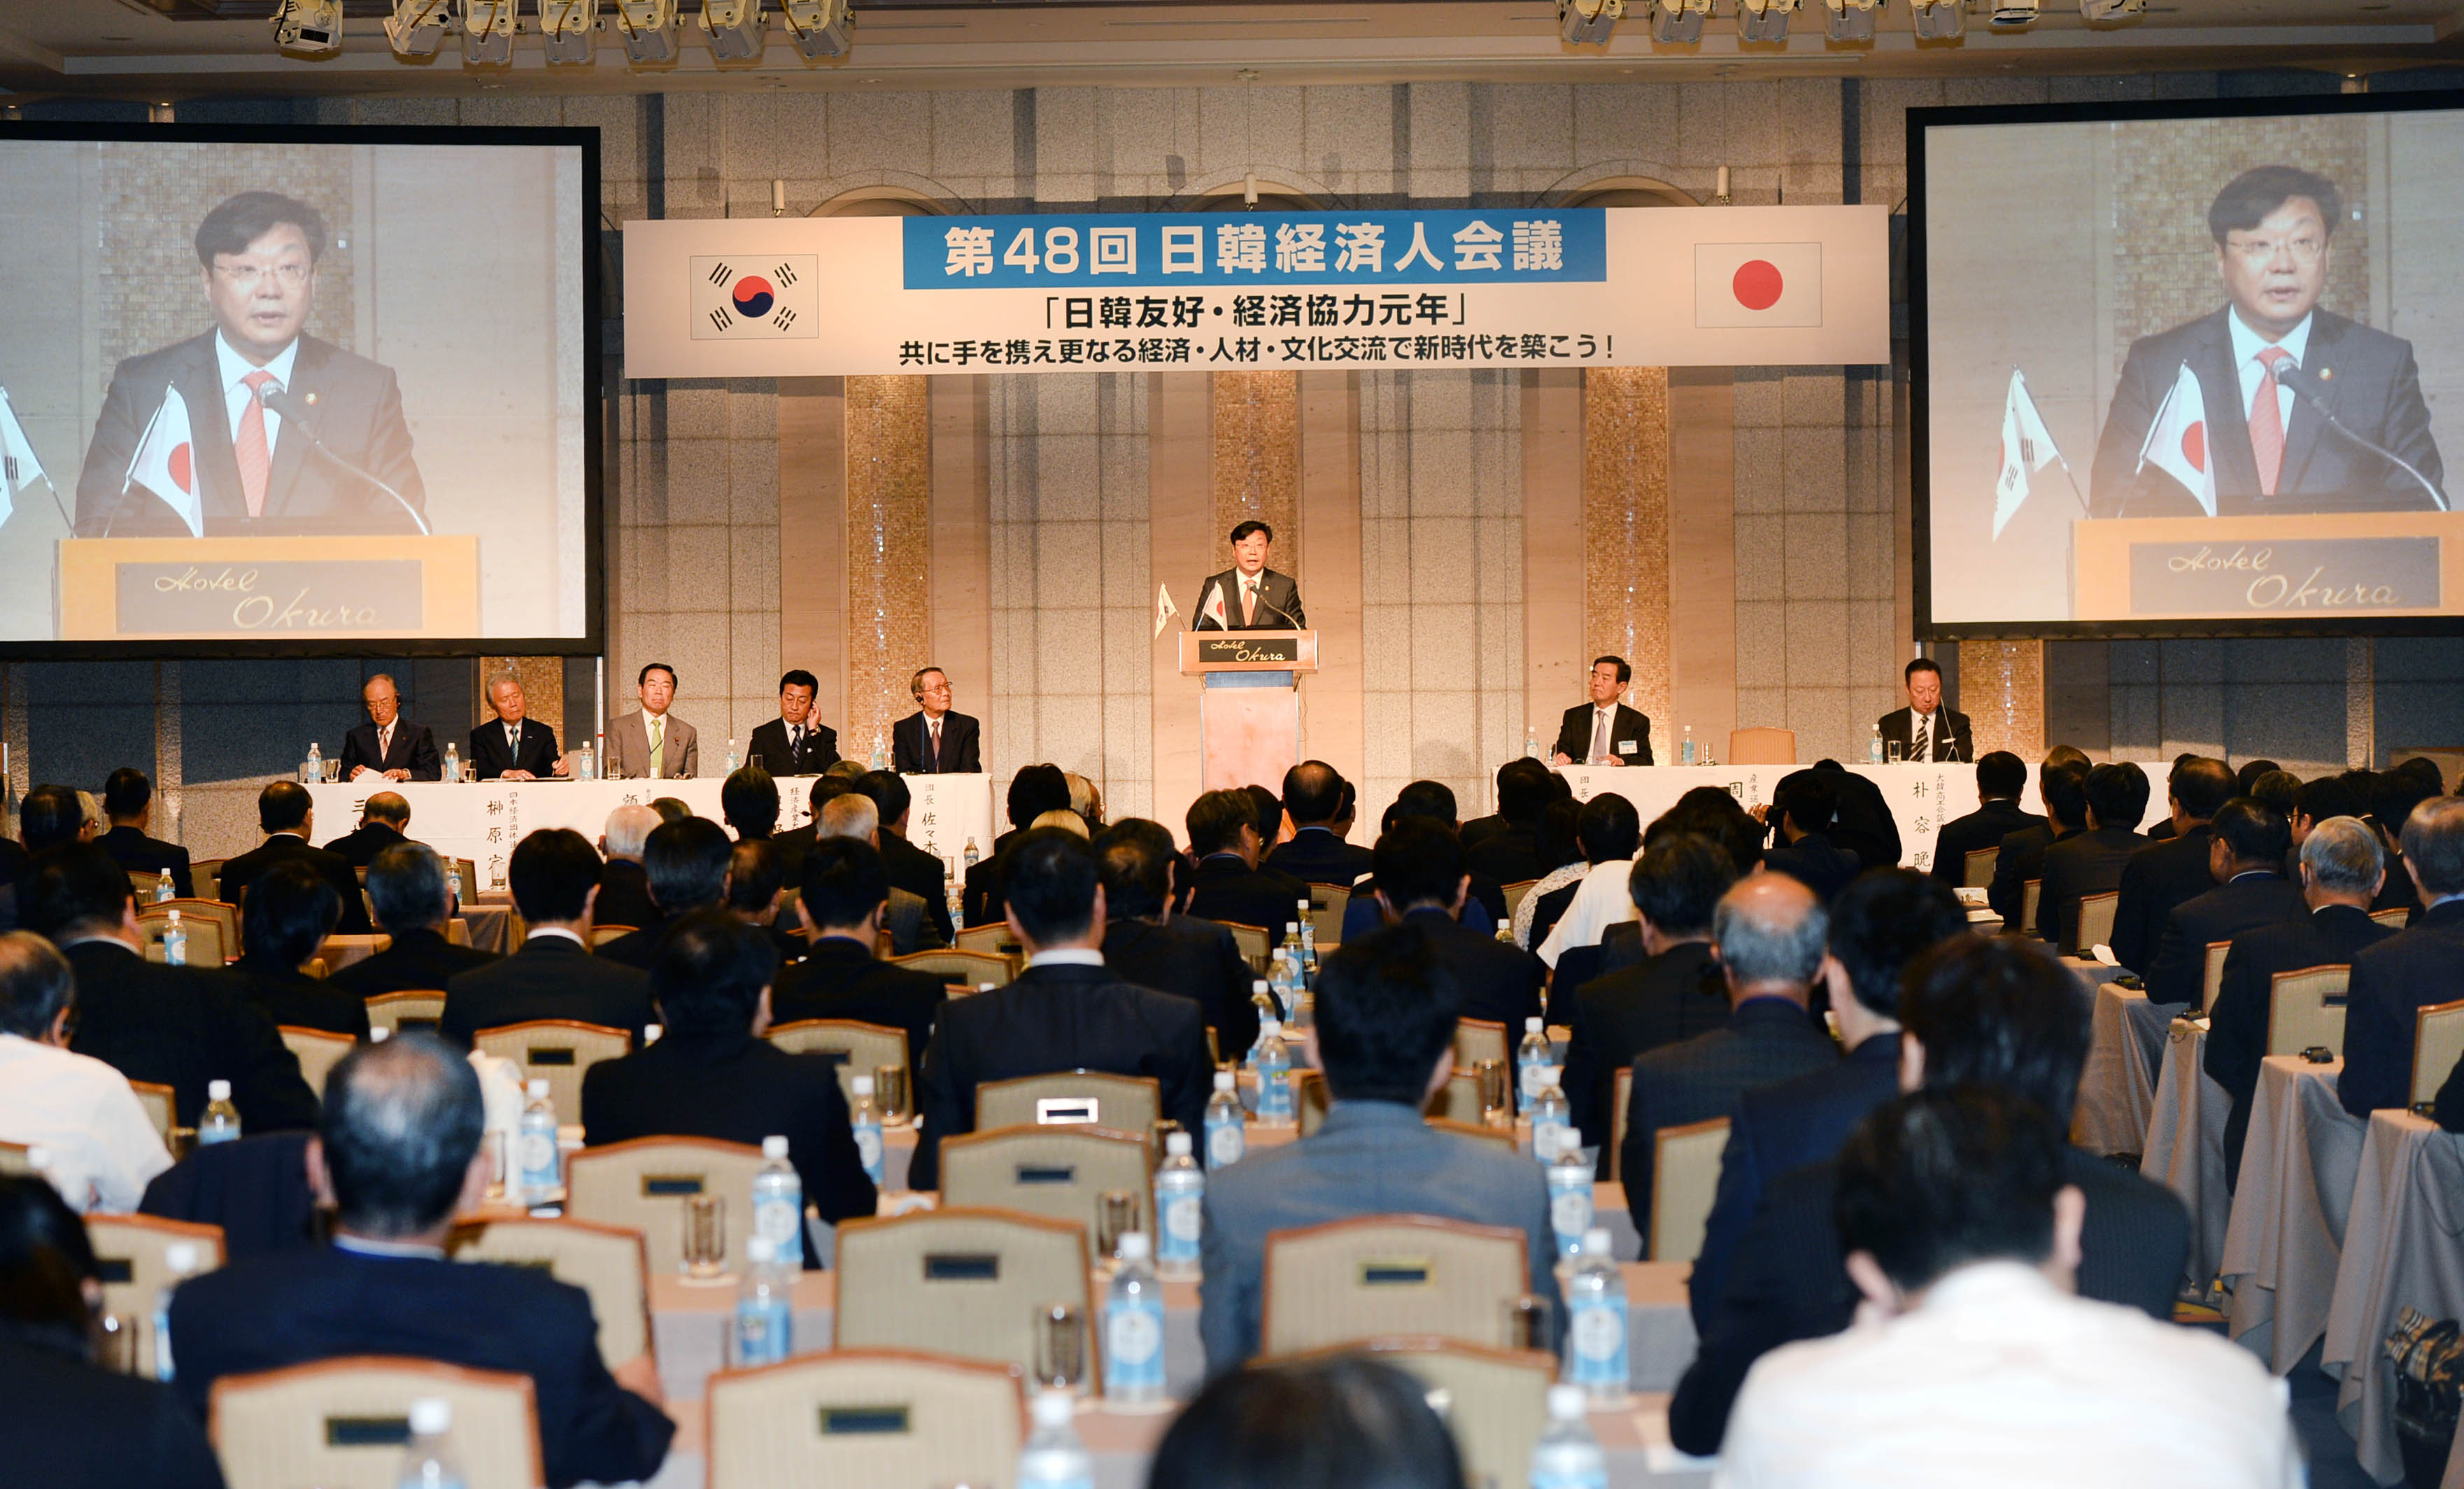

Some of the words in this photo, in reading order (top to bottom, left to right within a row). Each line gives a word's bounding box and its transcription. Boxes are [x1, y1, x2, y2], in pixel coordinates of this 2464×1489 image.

[944, 225, 1138, 278] 第48回
[1161, 220, 1564, 275] 日韓経済人会議
[2168, 546, 2273, 571] Hotel
[154, 566, 259, 592] Hotel
[2246, 566, 2400, 608] Okura
[232, 587, 383, 629] Okura
[1210, 640, 1245, 650] Hotel
[1235, 647, 1286, 661] Okura
